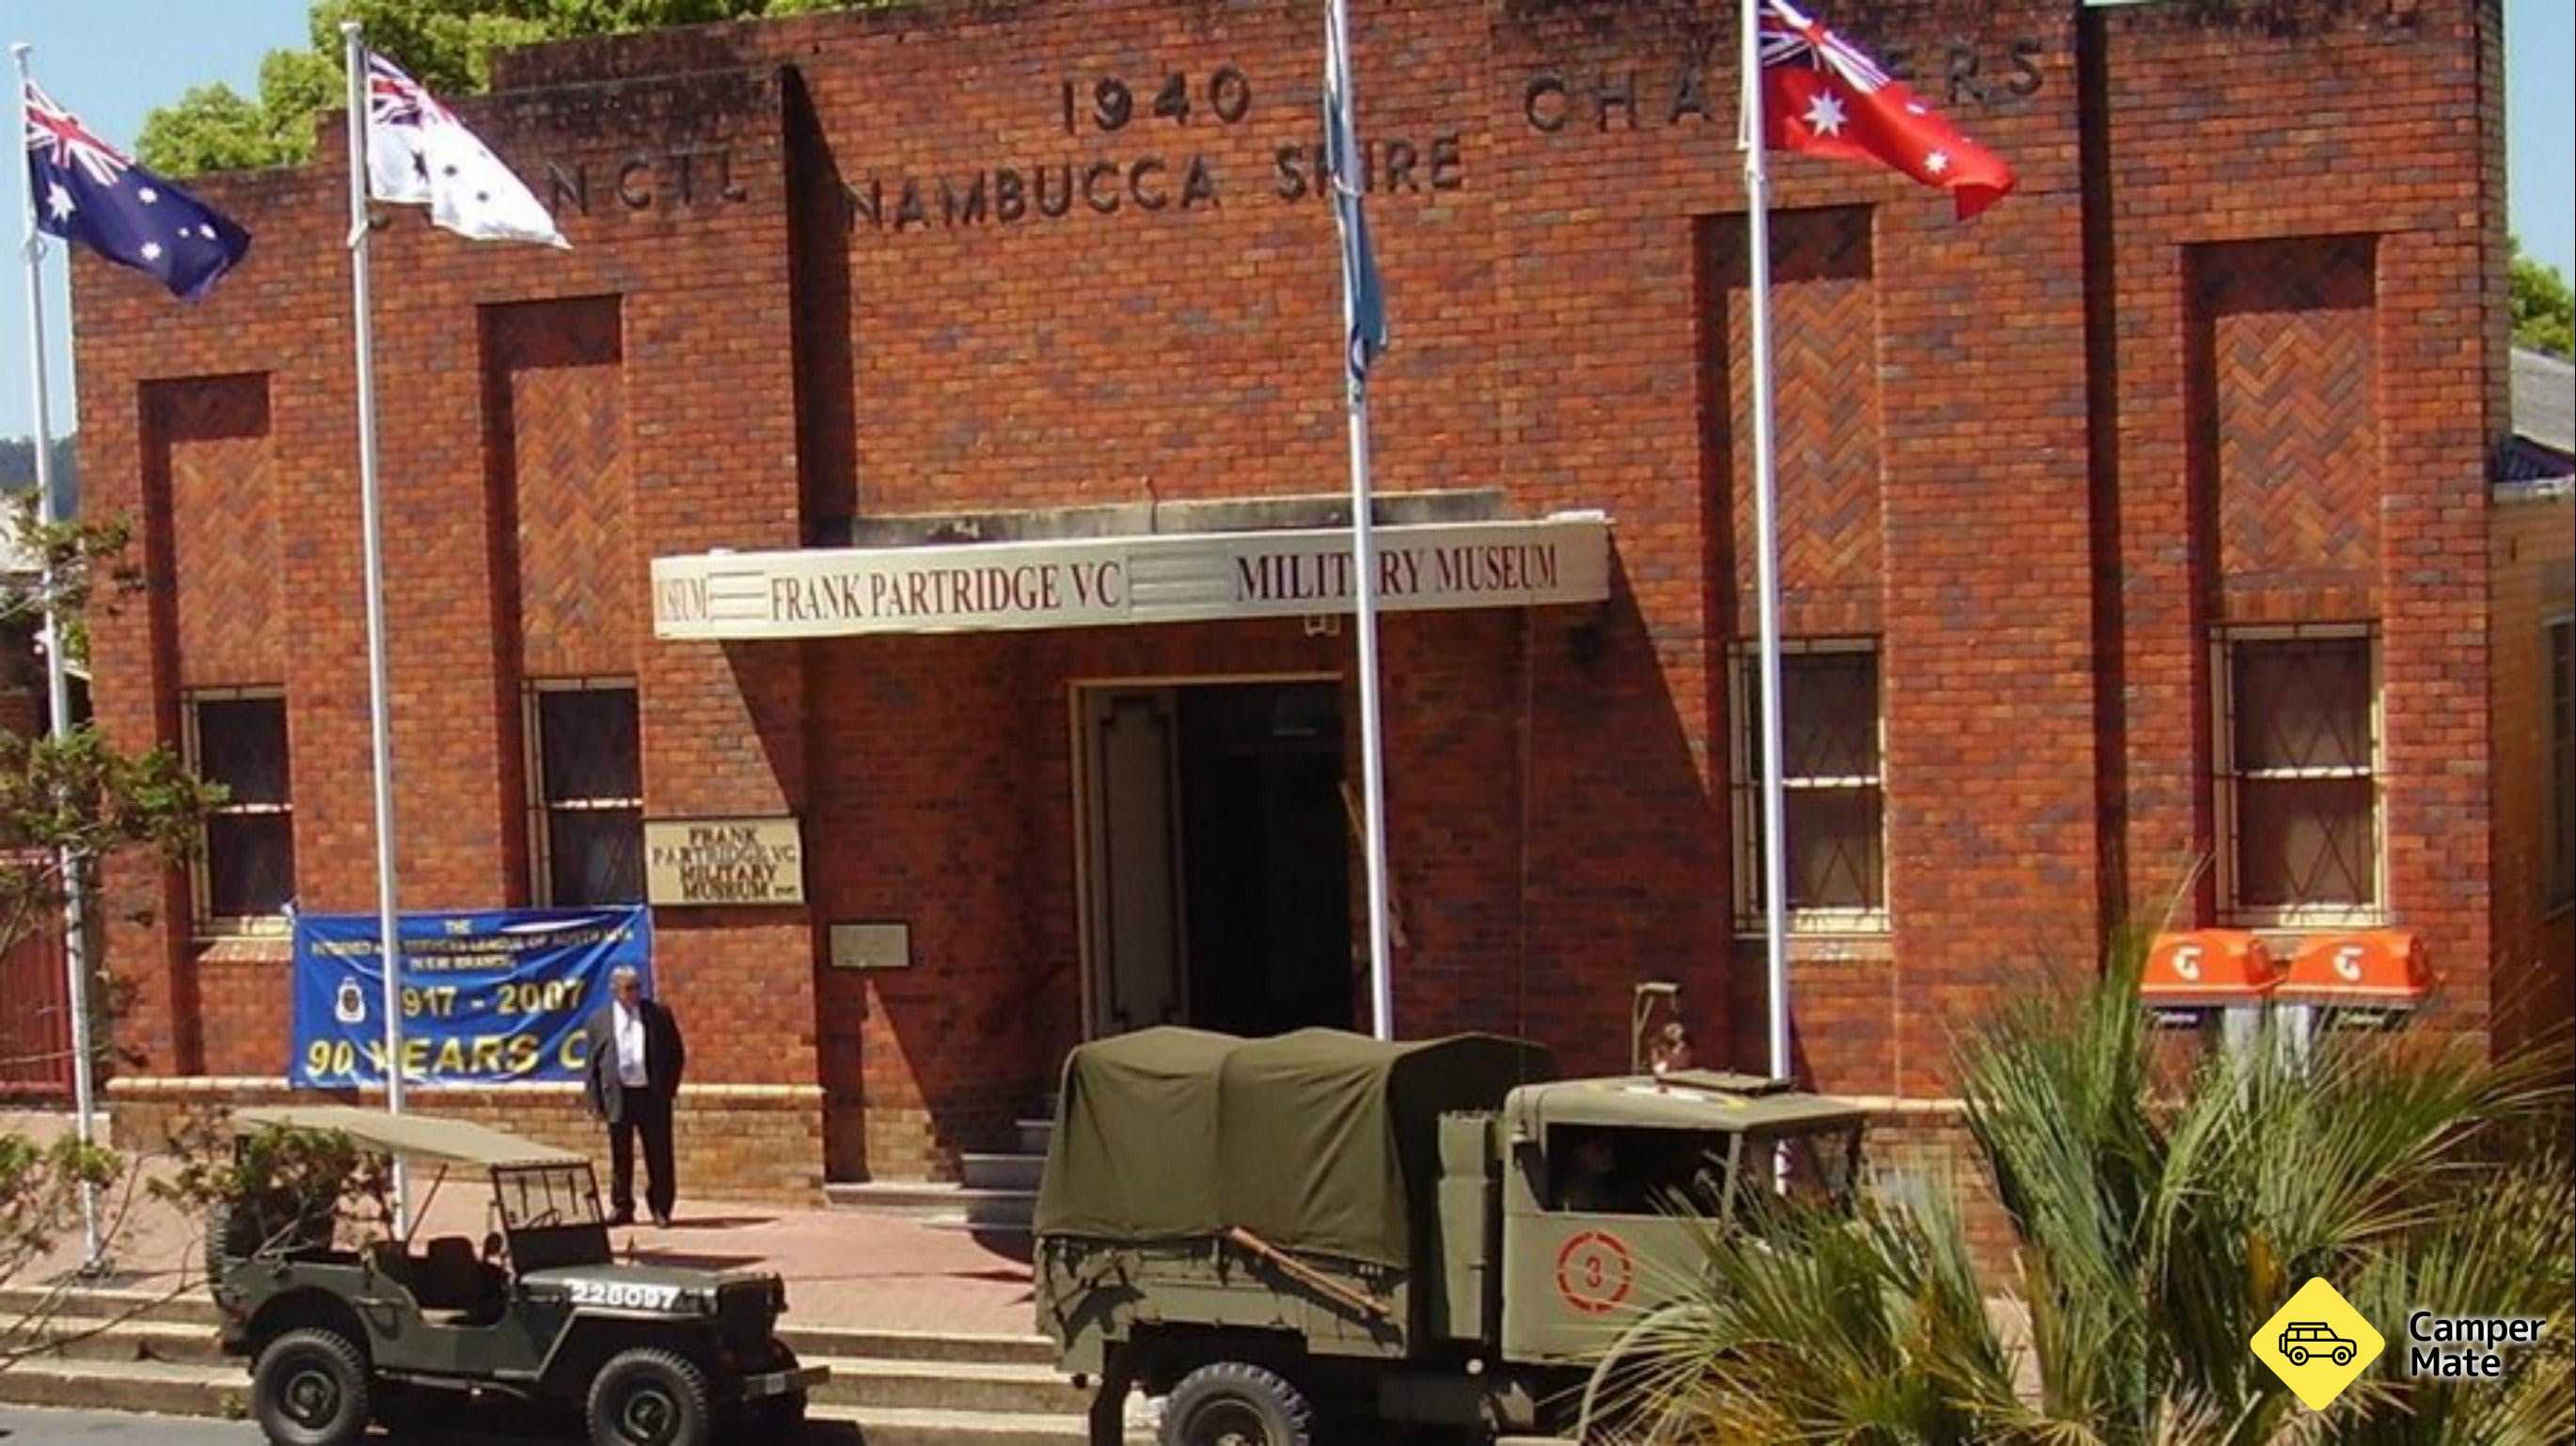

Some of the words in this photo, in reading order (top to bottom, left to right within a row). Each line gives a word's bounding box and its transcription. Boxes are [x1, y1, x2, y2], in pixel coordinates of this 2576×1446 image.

[1063, 65, 1251, 135] 1940
[1525, 32, 2044, 134] CHAERS
[845, 154, 1220, 233] NAMBUCCA
[770, 573, 872, 621] FRANK
[870, 563, 1062, 617] PARTRIDGE
[1071, 561, 1123, 608] VC
[1235, 546, 1426, 602] MILITRY
[1435, 542, 1559, 594] MUSEUM
[689, 827, 758, 845] FRANK
[680, 863, 777, 882] MILITARY
[683, 880, 770, 899] MUSEUM
[401, 985, 458, 1017] 917
[496, 978, 586, 1015] 2007
[305, 1039, 355, 1077] 90
[1585, 1255, 1603, 1289] 3
